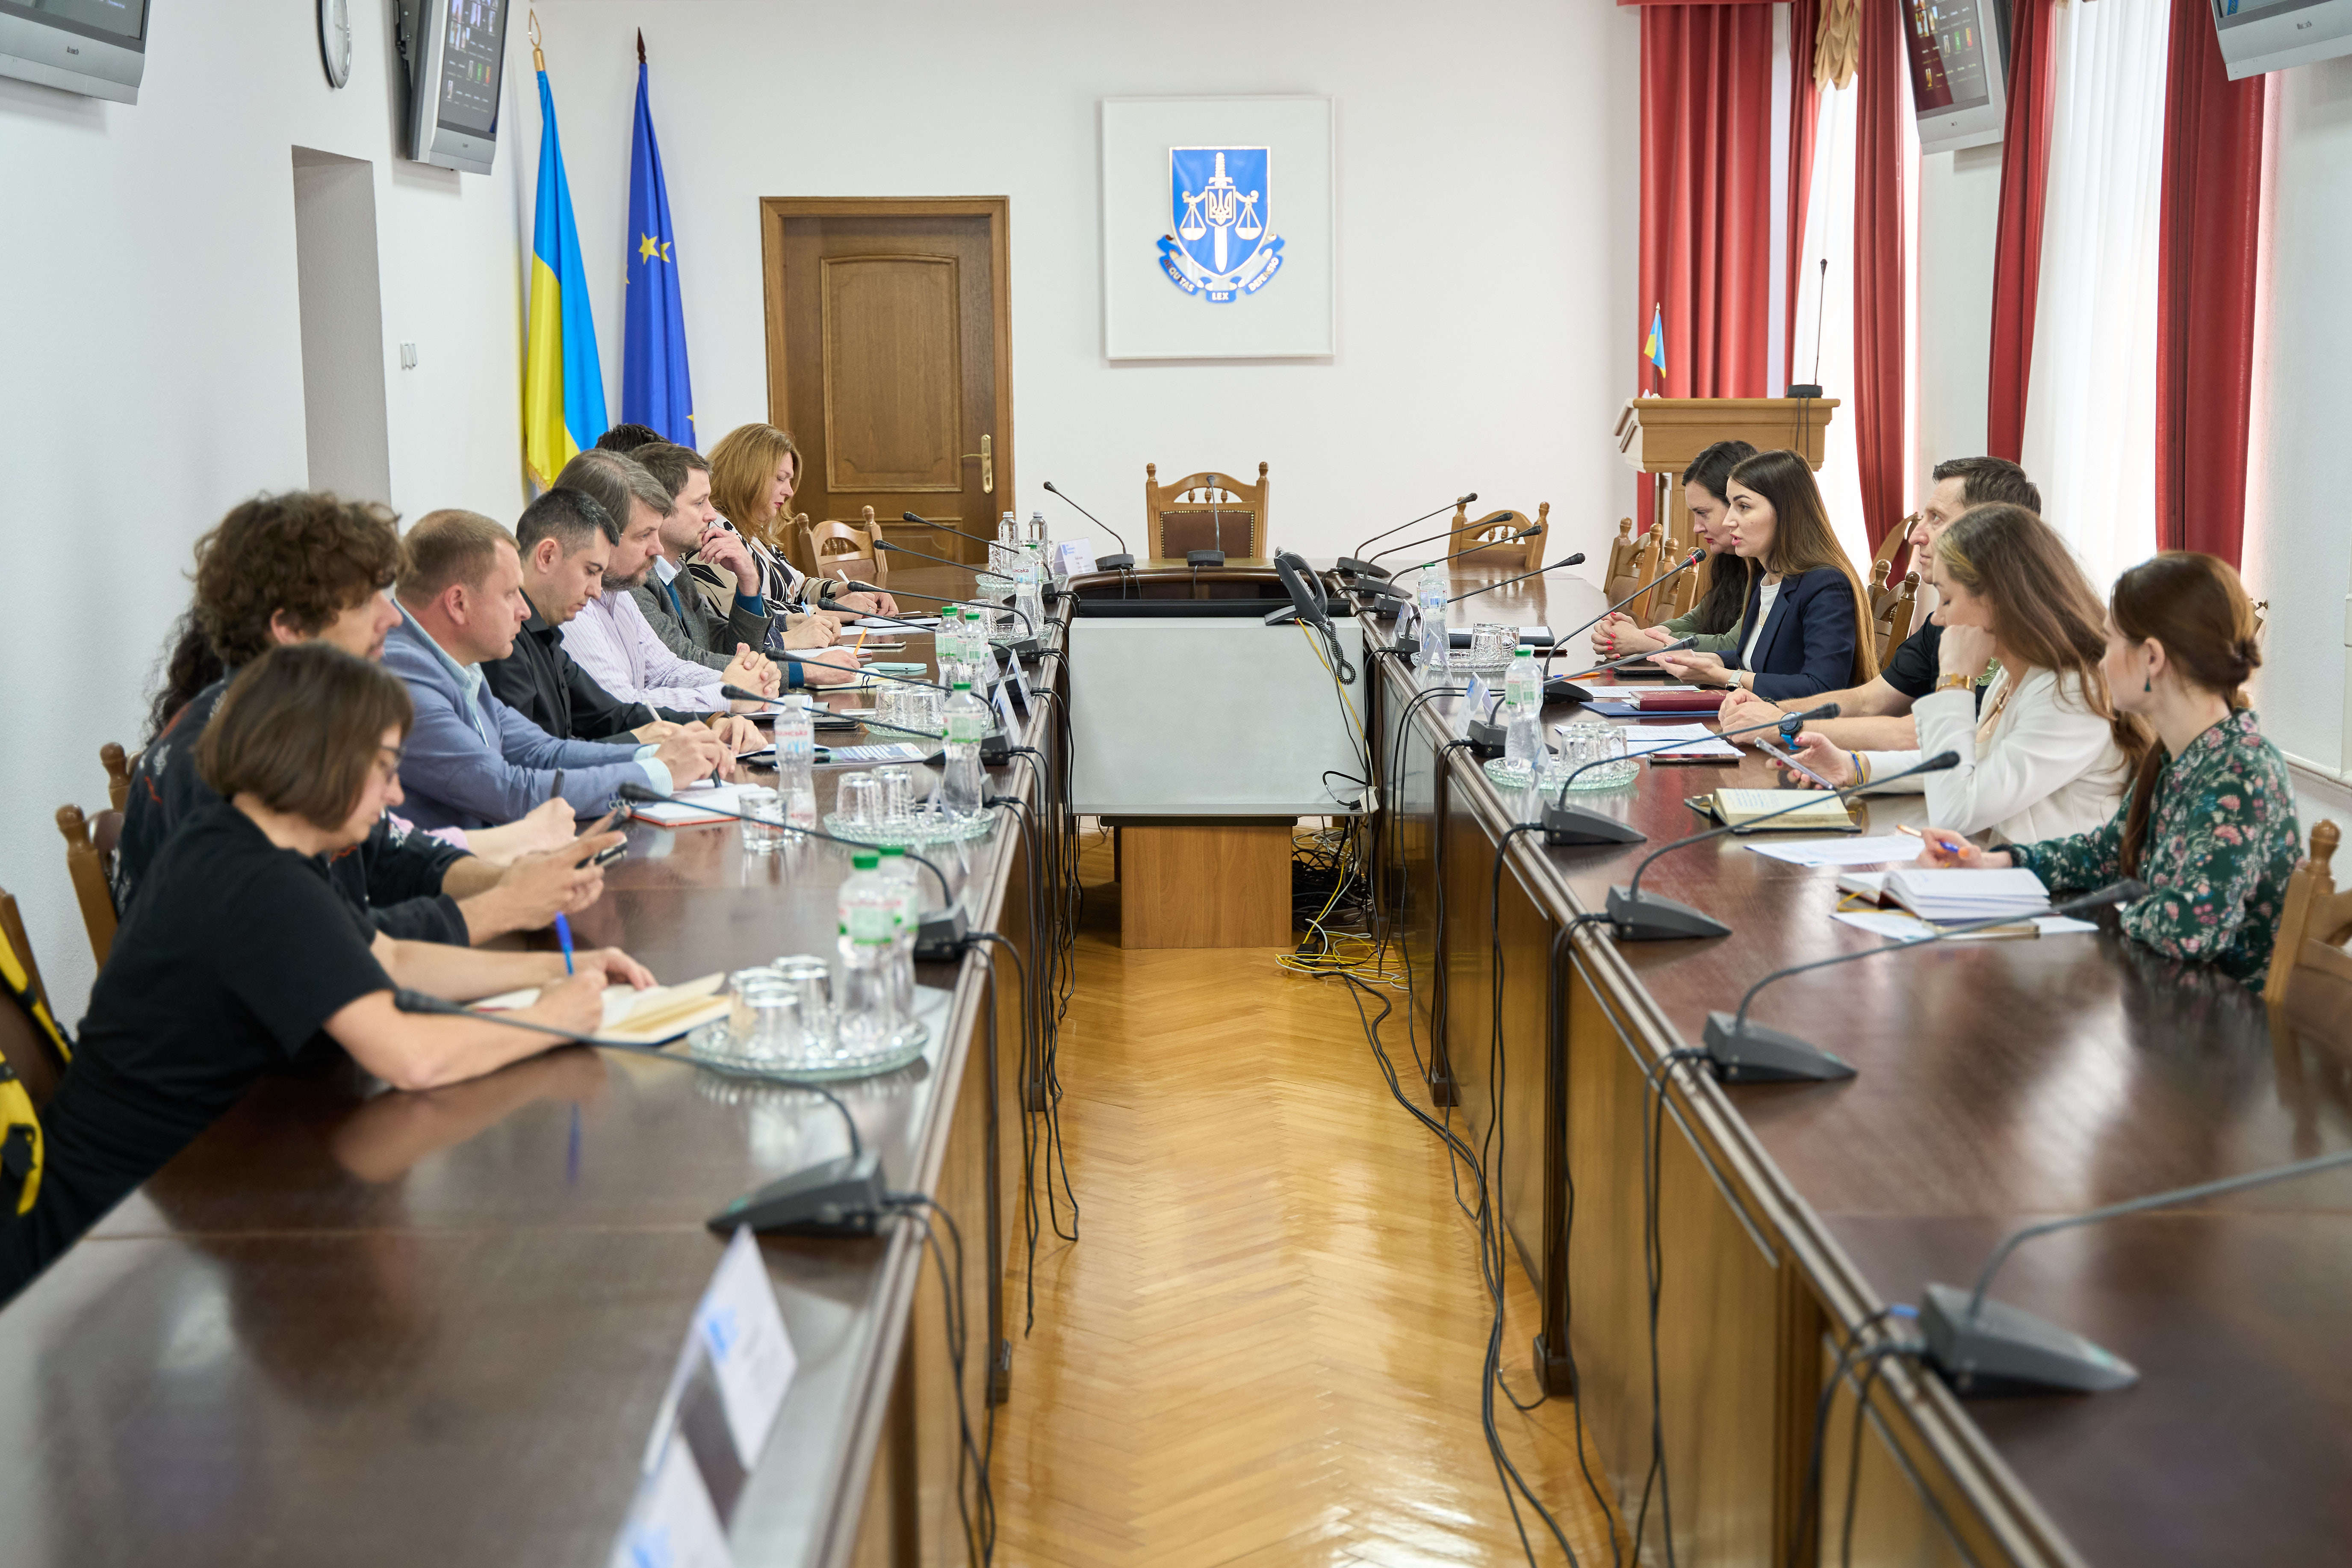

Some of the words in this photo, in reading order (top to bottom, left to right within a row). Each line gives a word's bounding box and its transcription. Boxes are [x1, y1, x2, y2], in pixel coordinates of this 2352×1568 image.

[1163, 259, 1195, 292] AEQUITAS
[1212, 292, 1229, 300] LEX
[1248, 257, 1279, 291] DEFENSIO
